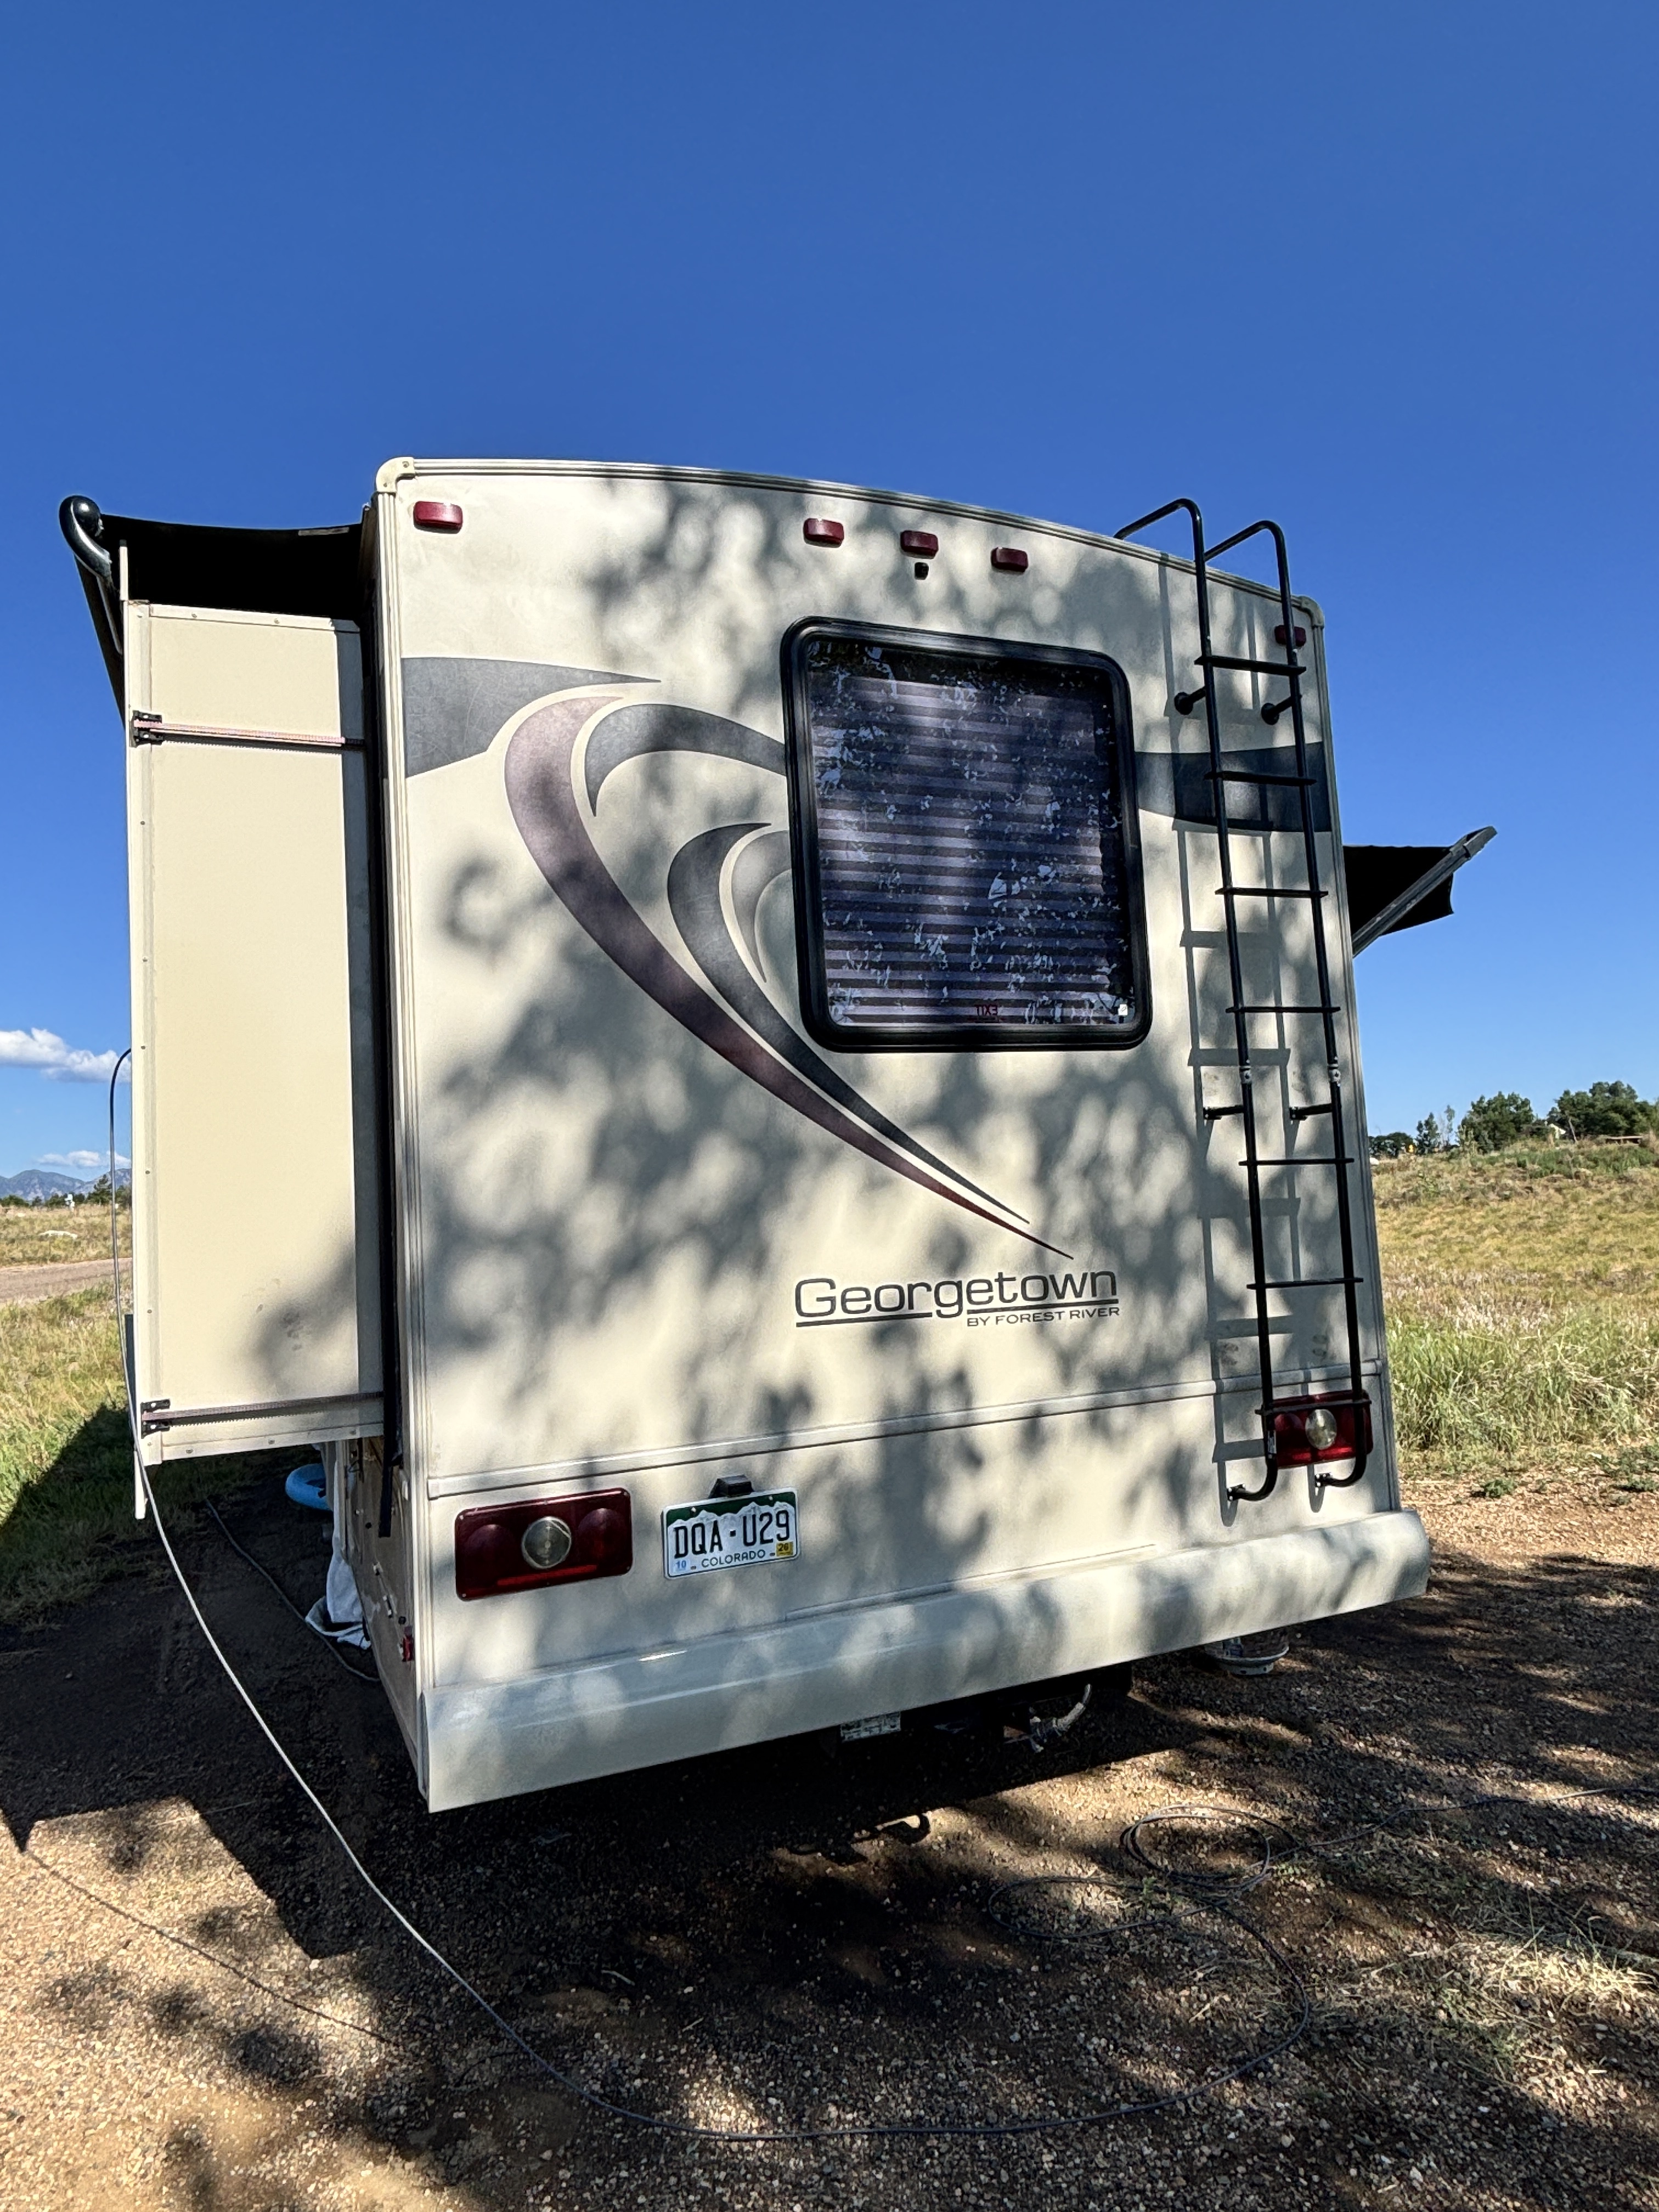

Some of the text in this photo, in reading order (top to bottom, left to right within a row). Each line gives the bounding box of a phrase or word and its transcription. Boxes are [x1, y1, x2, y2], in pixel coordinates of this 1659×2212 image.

[794, 1270, 1118, 1318] Georgetown
[967, 1307, 1120, 1327] BY FOREST RIVER
[701, 1549, 766, 1568] COLORADO
